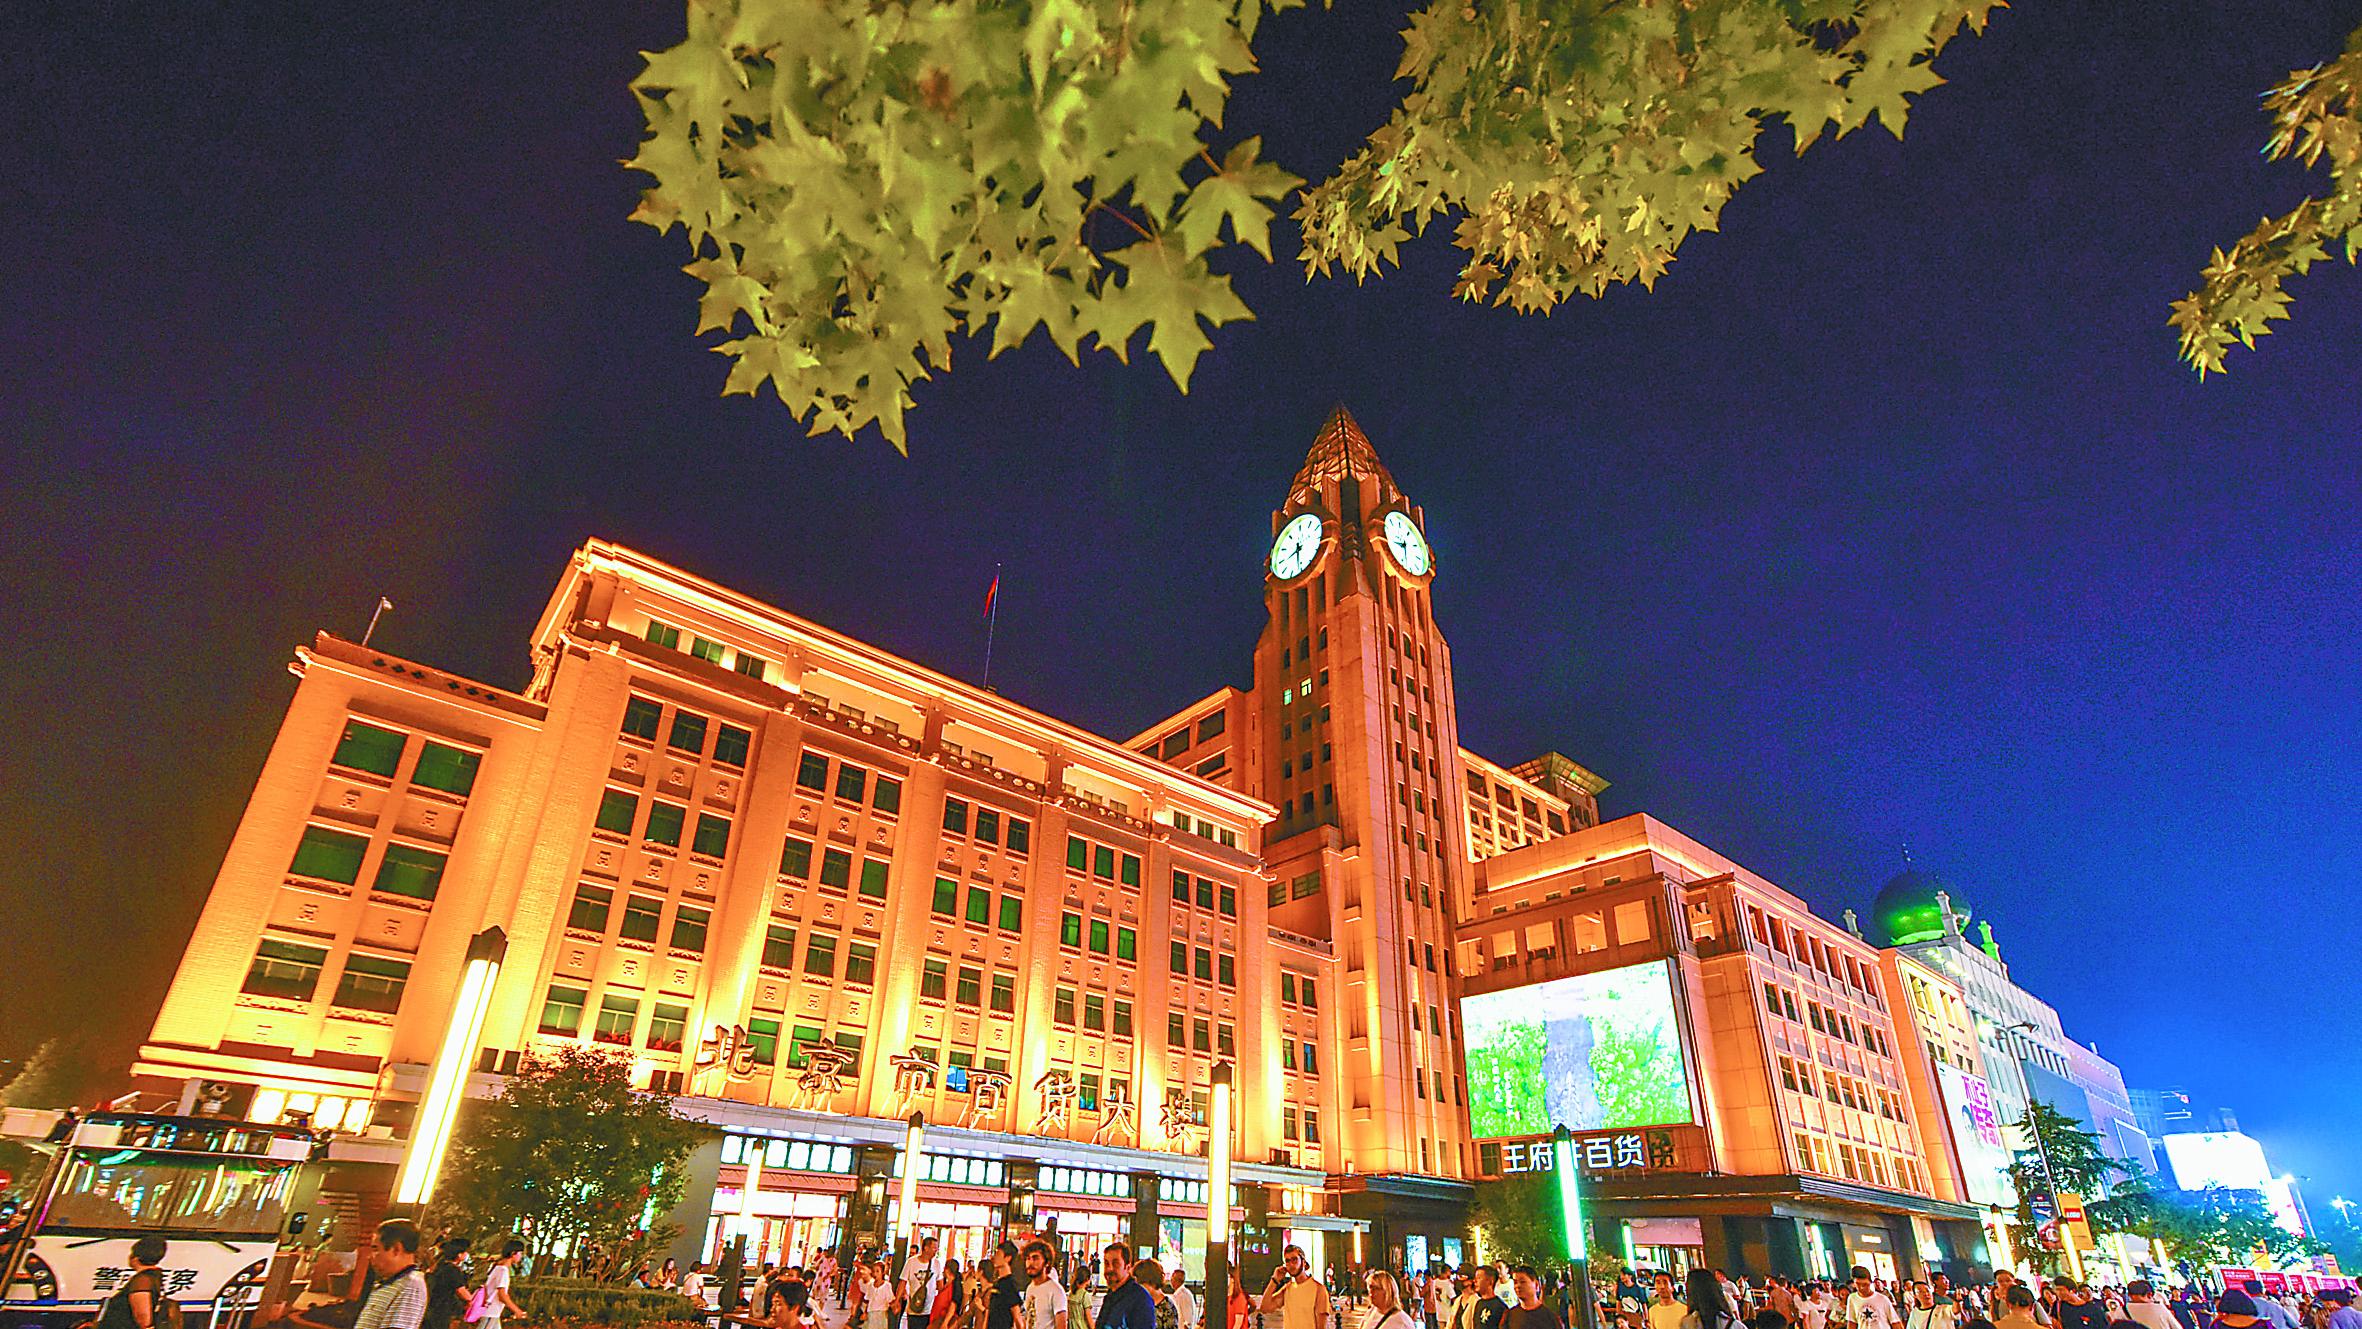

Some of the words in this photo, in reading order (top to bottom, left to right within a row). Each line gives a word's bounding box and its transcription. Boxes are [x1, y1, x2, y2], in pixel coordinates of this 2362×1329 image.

[695, 1025, 1194, 1140] 北京市百货大楼
